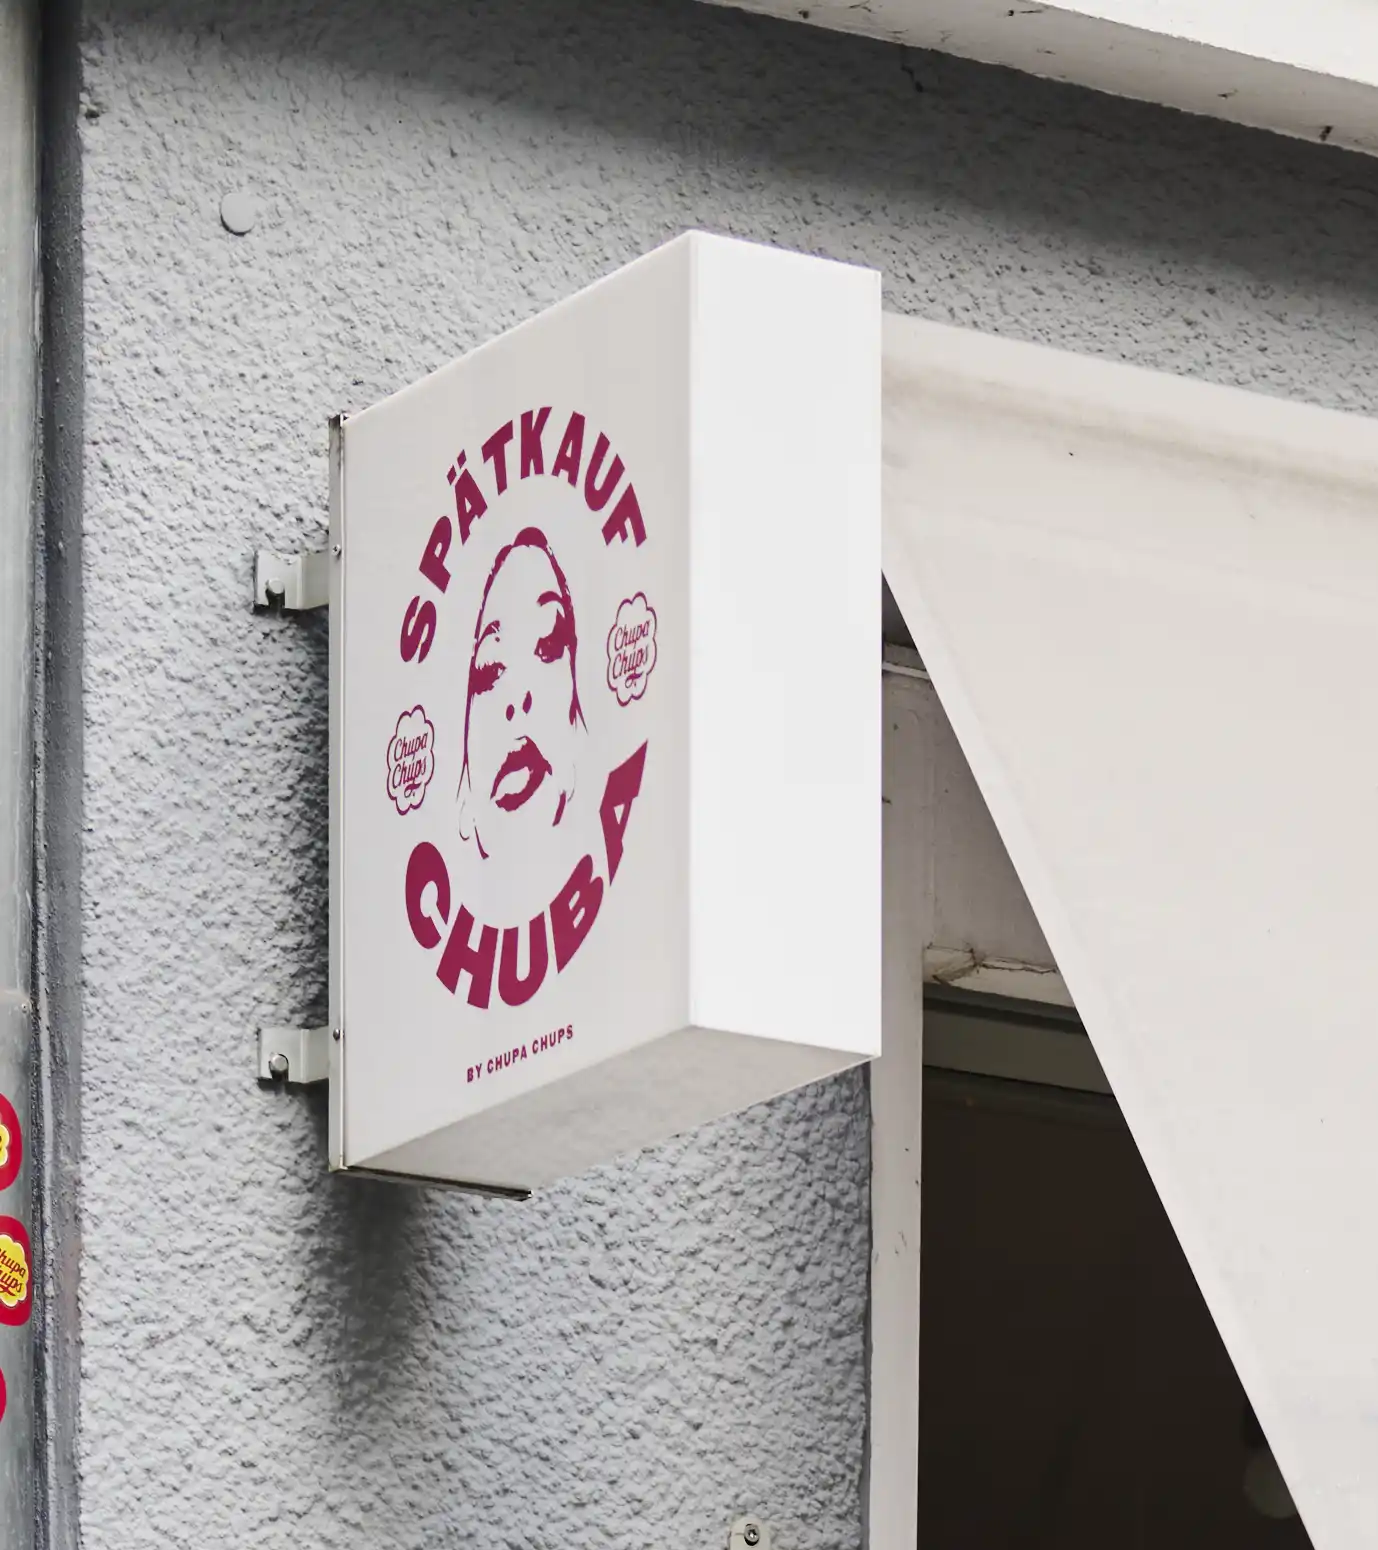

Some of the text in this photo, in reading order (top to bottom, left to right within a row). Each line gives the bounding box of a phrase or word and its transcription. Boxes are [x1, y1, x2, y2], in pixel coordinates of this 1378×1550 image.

[400, 406, 648, 664] SPÄTKAUF
[614, 619, 651, 652] Chupa
[612, 643, 650, 689] Chups
[393, 731, 429, 763] Chupa
[391, 754, 427, 799] Chups
[404, 739, 649, 1010] CHUBA
[466, 1023, 574, 1084] BY CHUPA CHUPS
